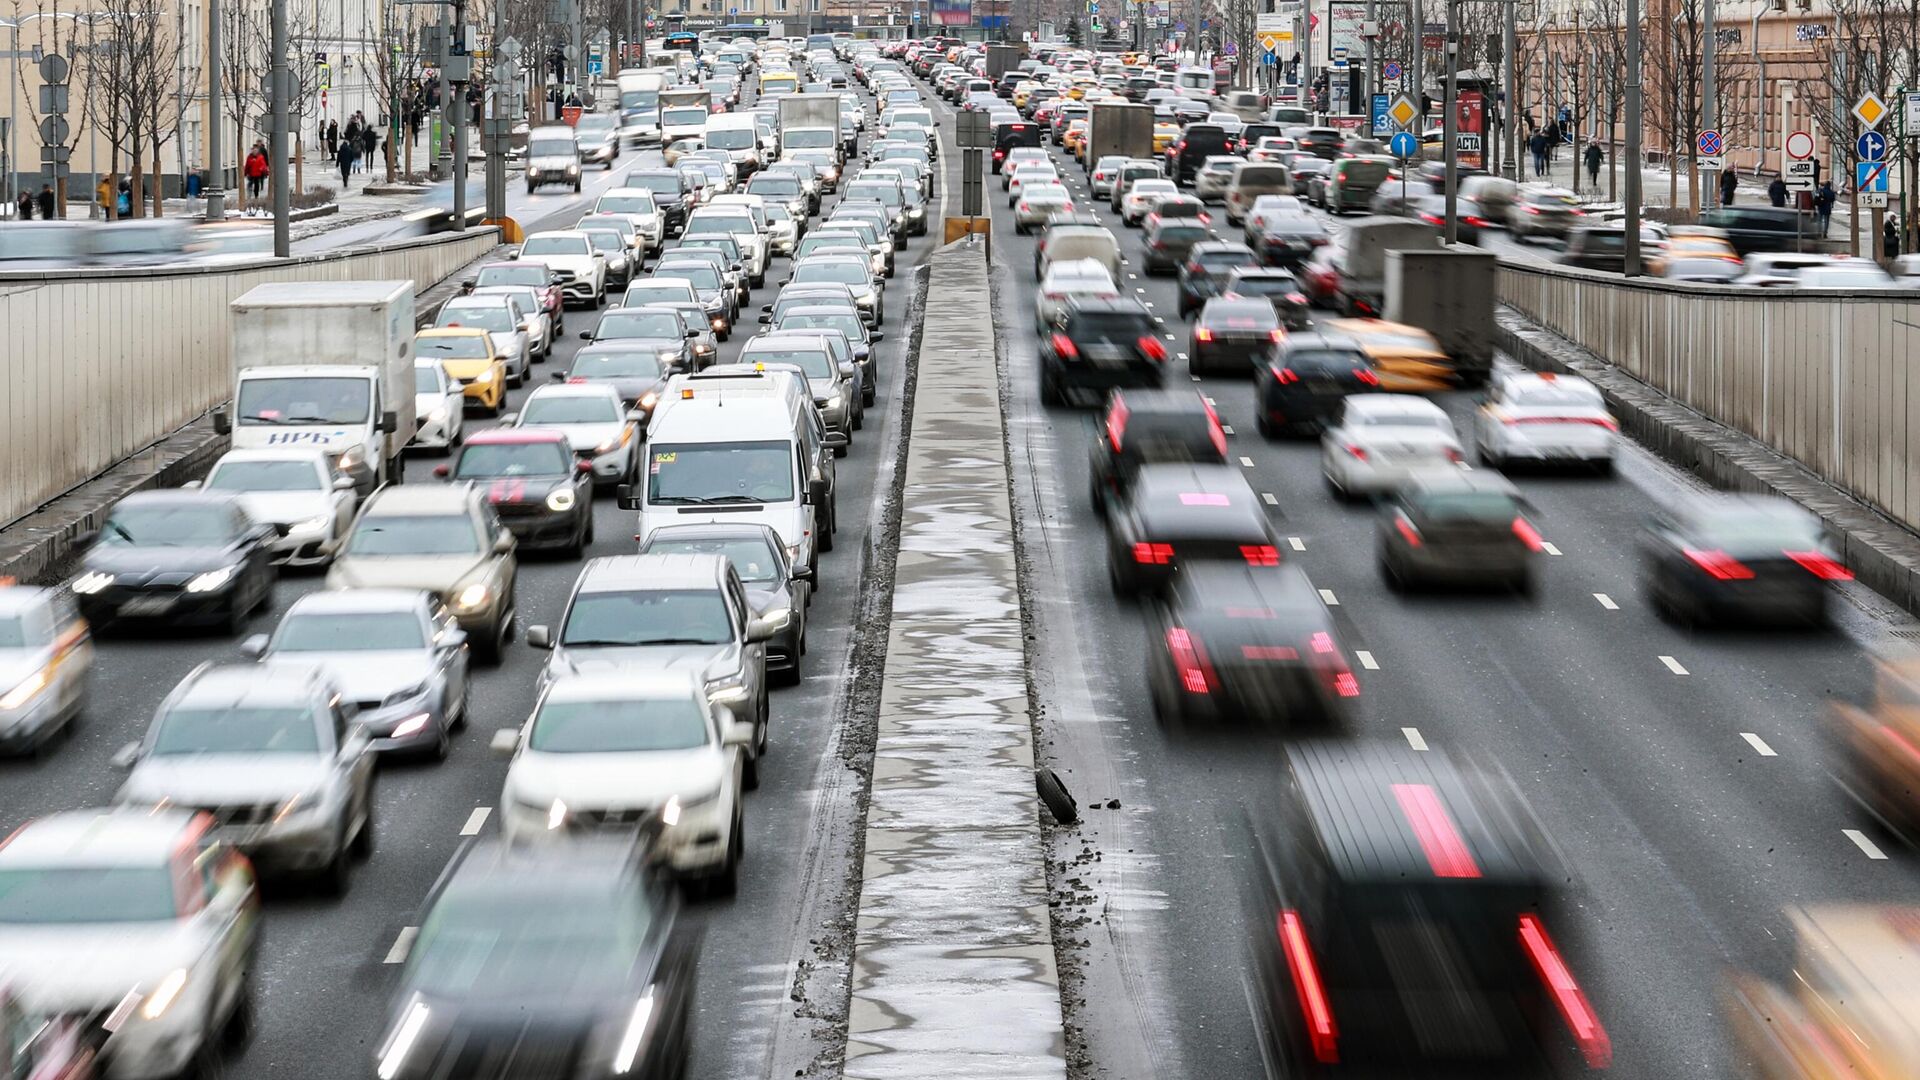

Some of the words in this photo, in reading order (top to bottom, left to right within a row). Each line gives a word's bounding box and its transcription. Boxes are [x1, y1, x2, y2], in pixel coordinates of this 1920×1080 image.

[1456, 137, 1480, 150] АСТА
[1862, 196, 1873, 204] 15
[268, 432, 330, 445] НРБ
